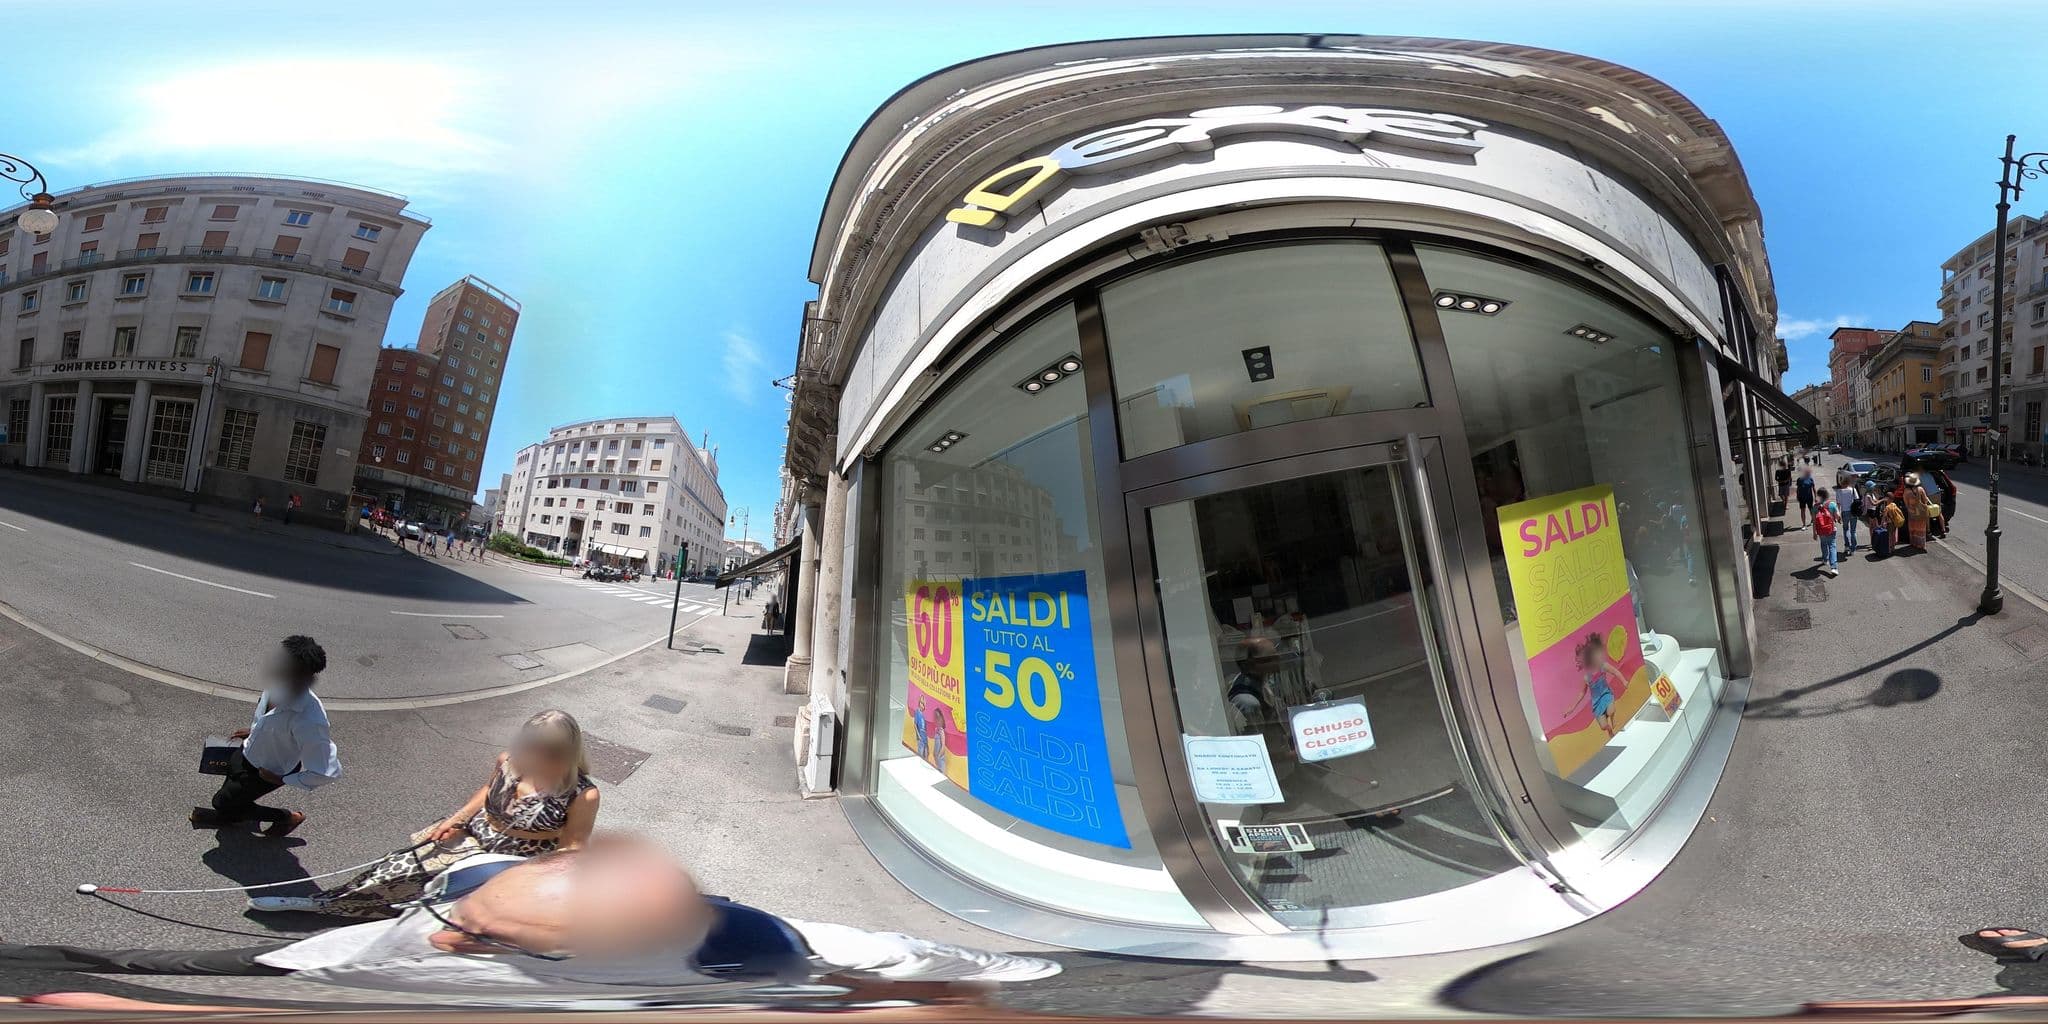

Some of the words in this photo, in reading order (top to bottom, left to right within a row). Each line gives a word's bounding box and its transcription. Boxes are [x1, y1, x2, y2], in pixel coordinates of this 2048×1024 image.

[52, 365, 82, 373] JOHN
[85, 361, 117, 371] REED
[120, 360, 187, 372] FITNESS
[1519, 497, 1610, 558] SALDI
[1529, 534, 1616, 602] SALDI
[971, 591, 1070, 629] SALDI
[984, 628, 1028, 649] TUTTO
[1032, 634, 1056, 653] AL
[941, 672, 960, 695] CAPI
[974, 648, 1076, 722] -50%
[975, 711, 1089, 772] SALDI
[1303, 717, 1364, 736] CHIUSO
[1305, 730, 1368, 749] CLOSED
[977, 740, 1095, 803] SALDI
[978, 766, 1101, 830] SALDI
